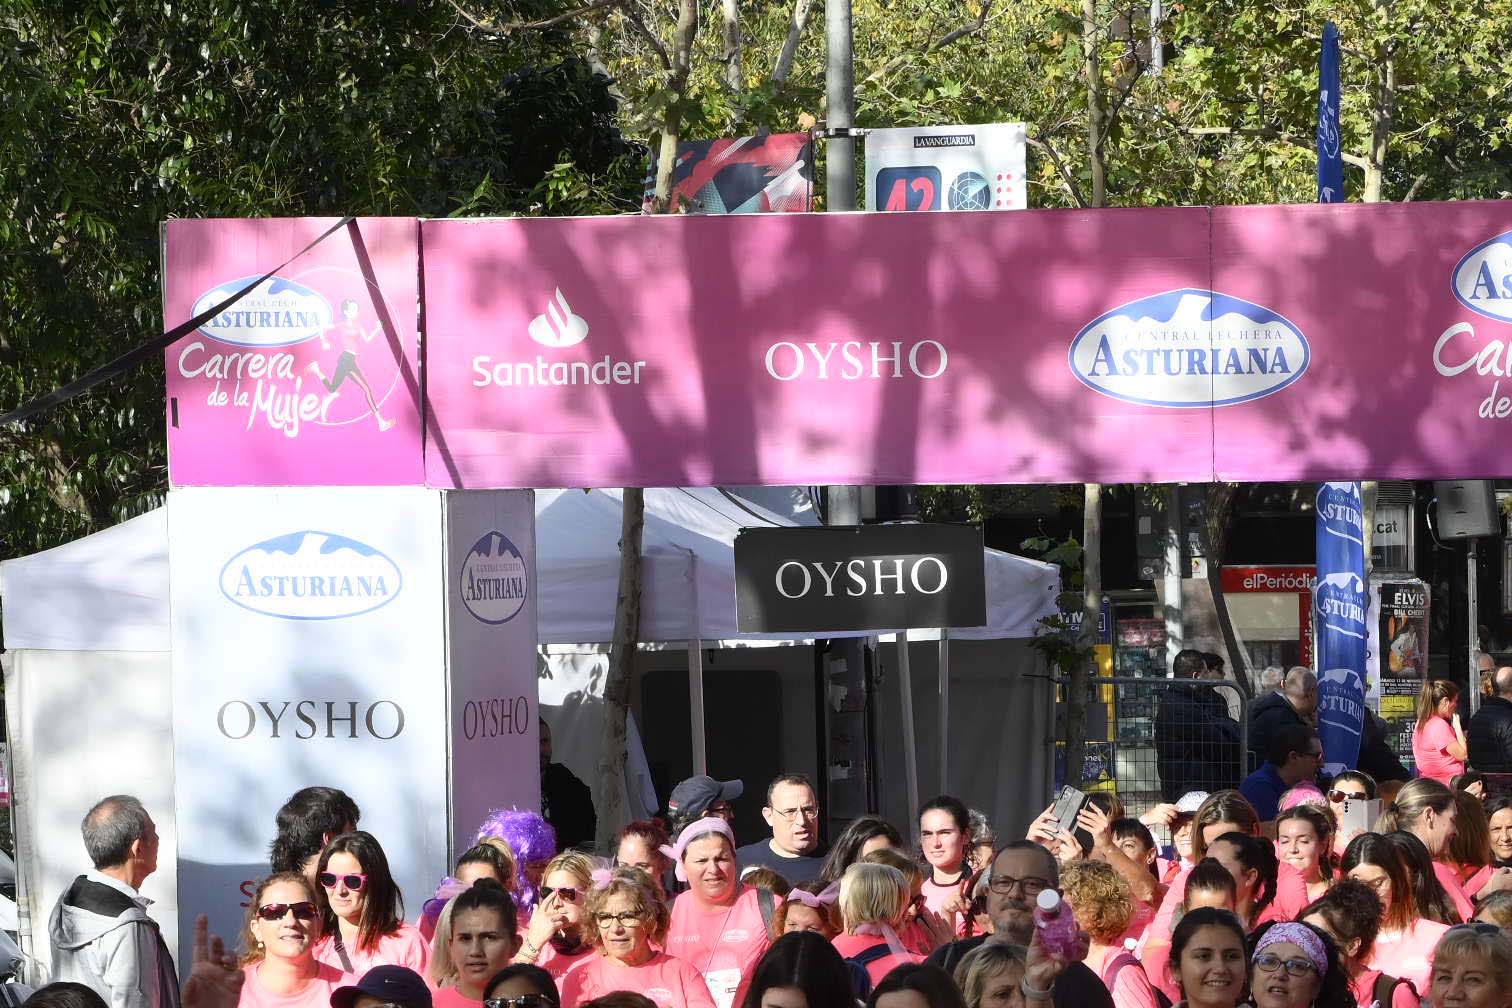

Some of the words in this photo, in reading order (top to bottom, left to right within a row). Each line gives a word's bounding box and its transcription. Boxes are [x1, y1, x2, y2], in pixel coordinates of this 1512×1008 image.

[178, 341, 295, 378] Carrera
[472, 355, 646, 387] Santander
[764, 340, 949, 382] OYSHO
[1087, 333, 1291, 377] ASTURIANA
[207, 380, 229, 407] de
[233, 380, 249, 407] la
[246, 376, 340, 438] Mujer
[1478, 382, 1512, 419] de
[234, 564, 389, 598] ASTURIANA
[466, 566, 524, 601] ASTURIANA
[775, 556, 949, 598] OYSHO
[1394, 592, 1424, 605] ELVIS
[217, 699, 405, 741] OYSHO
[463, 695, 529, 741] OYSHO
